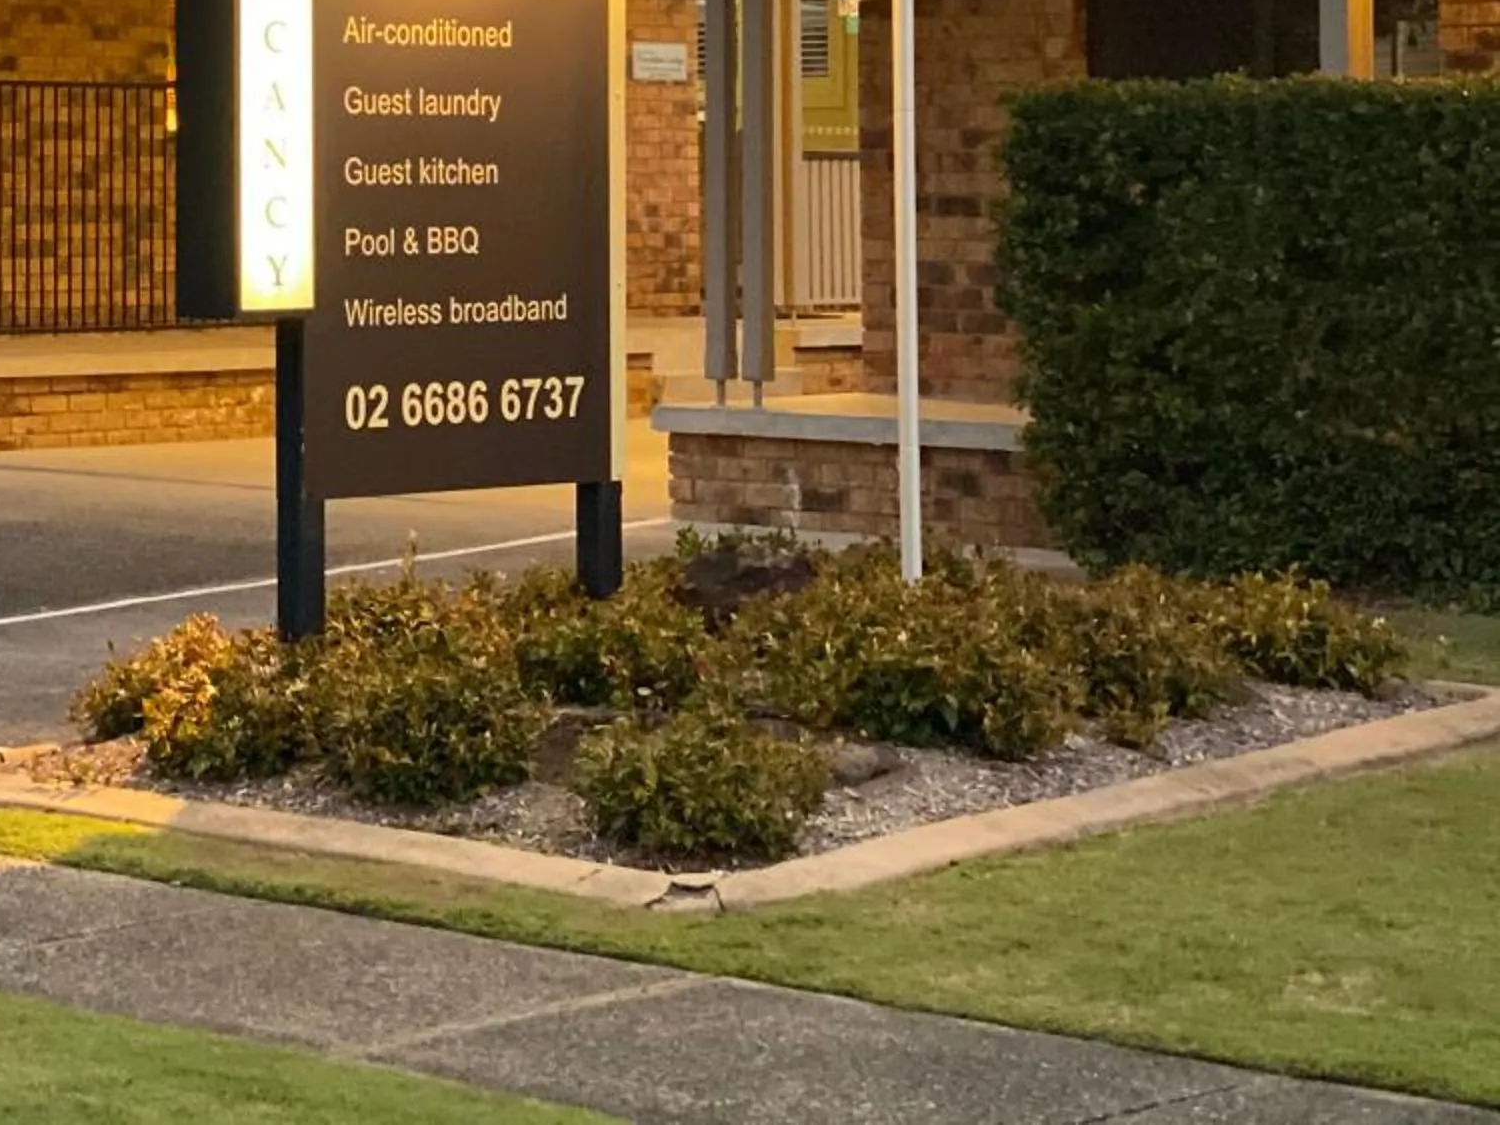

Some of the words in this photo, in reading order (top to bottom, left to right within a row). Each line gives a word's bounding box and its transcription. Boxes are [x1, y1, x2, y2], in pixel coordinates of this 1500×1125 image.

[342, 15, 512, 48] Air-conditioned
[343, 85, 412, 116] Guest
[419, 86, 502, 123] laundry
[344, 156, 413, 186] Guest
[419, 156, 499, 185] kitchen
[345, 227, 395, 256] Pool
[403, 226, 420, 255] &
[427, 226, 479, 255] BBQ
[344, 298, 443, 327] Wireless
[449, 293, 567, 324] broadband
[345, 384, 389, 430] 02
[401, 380, 489, 427] 6686
[501, 376, 585, 422] 6737
